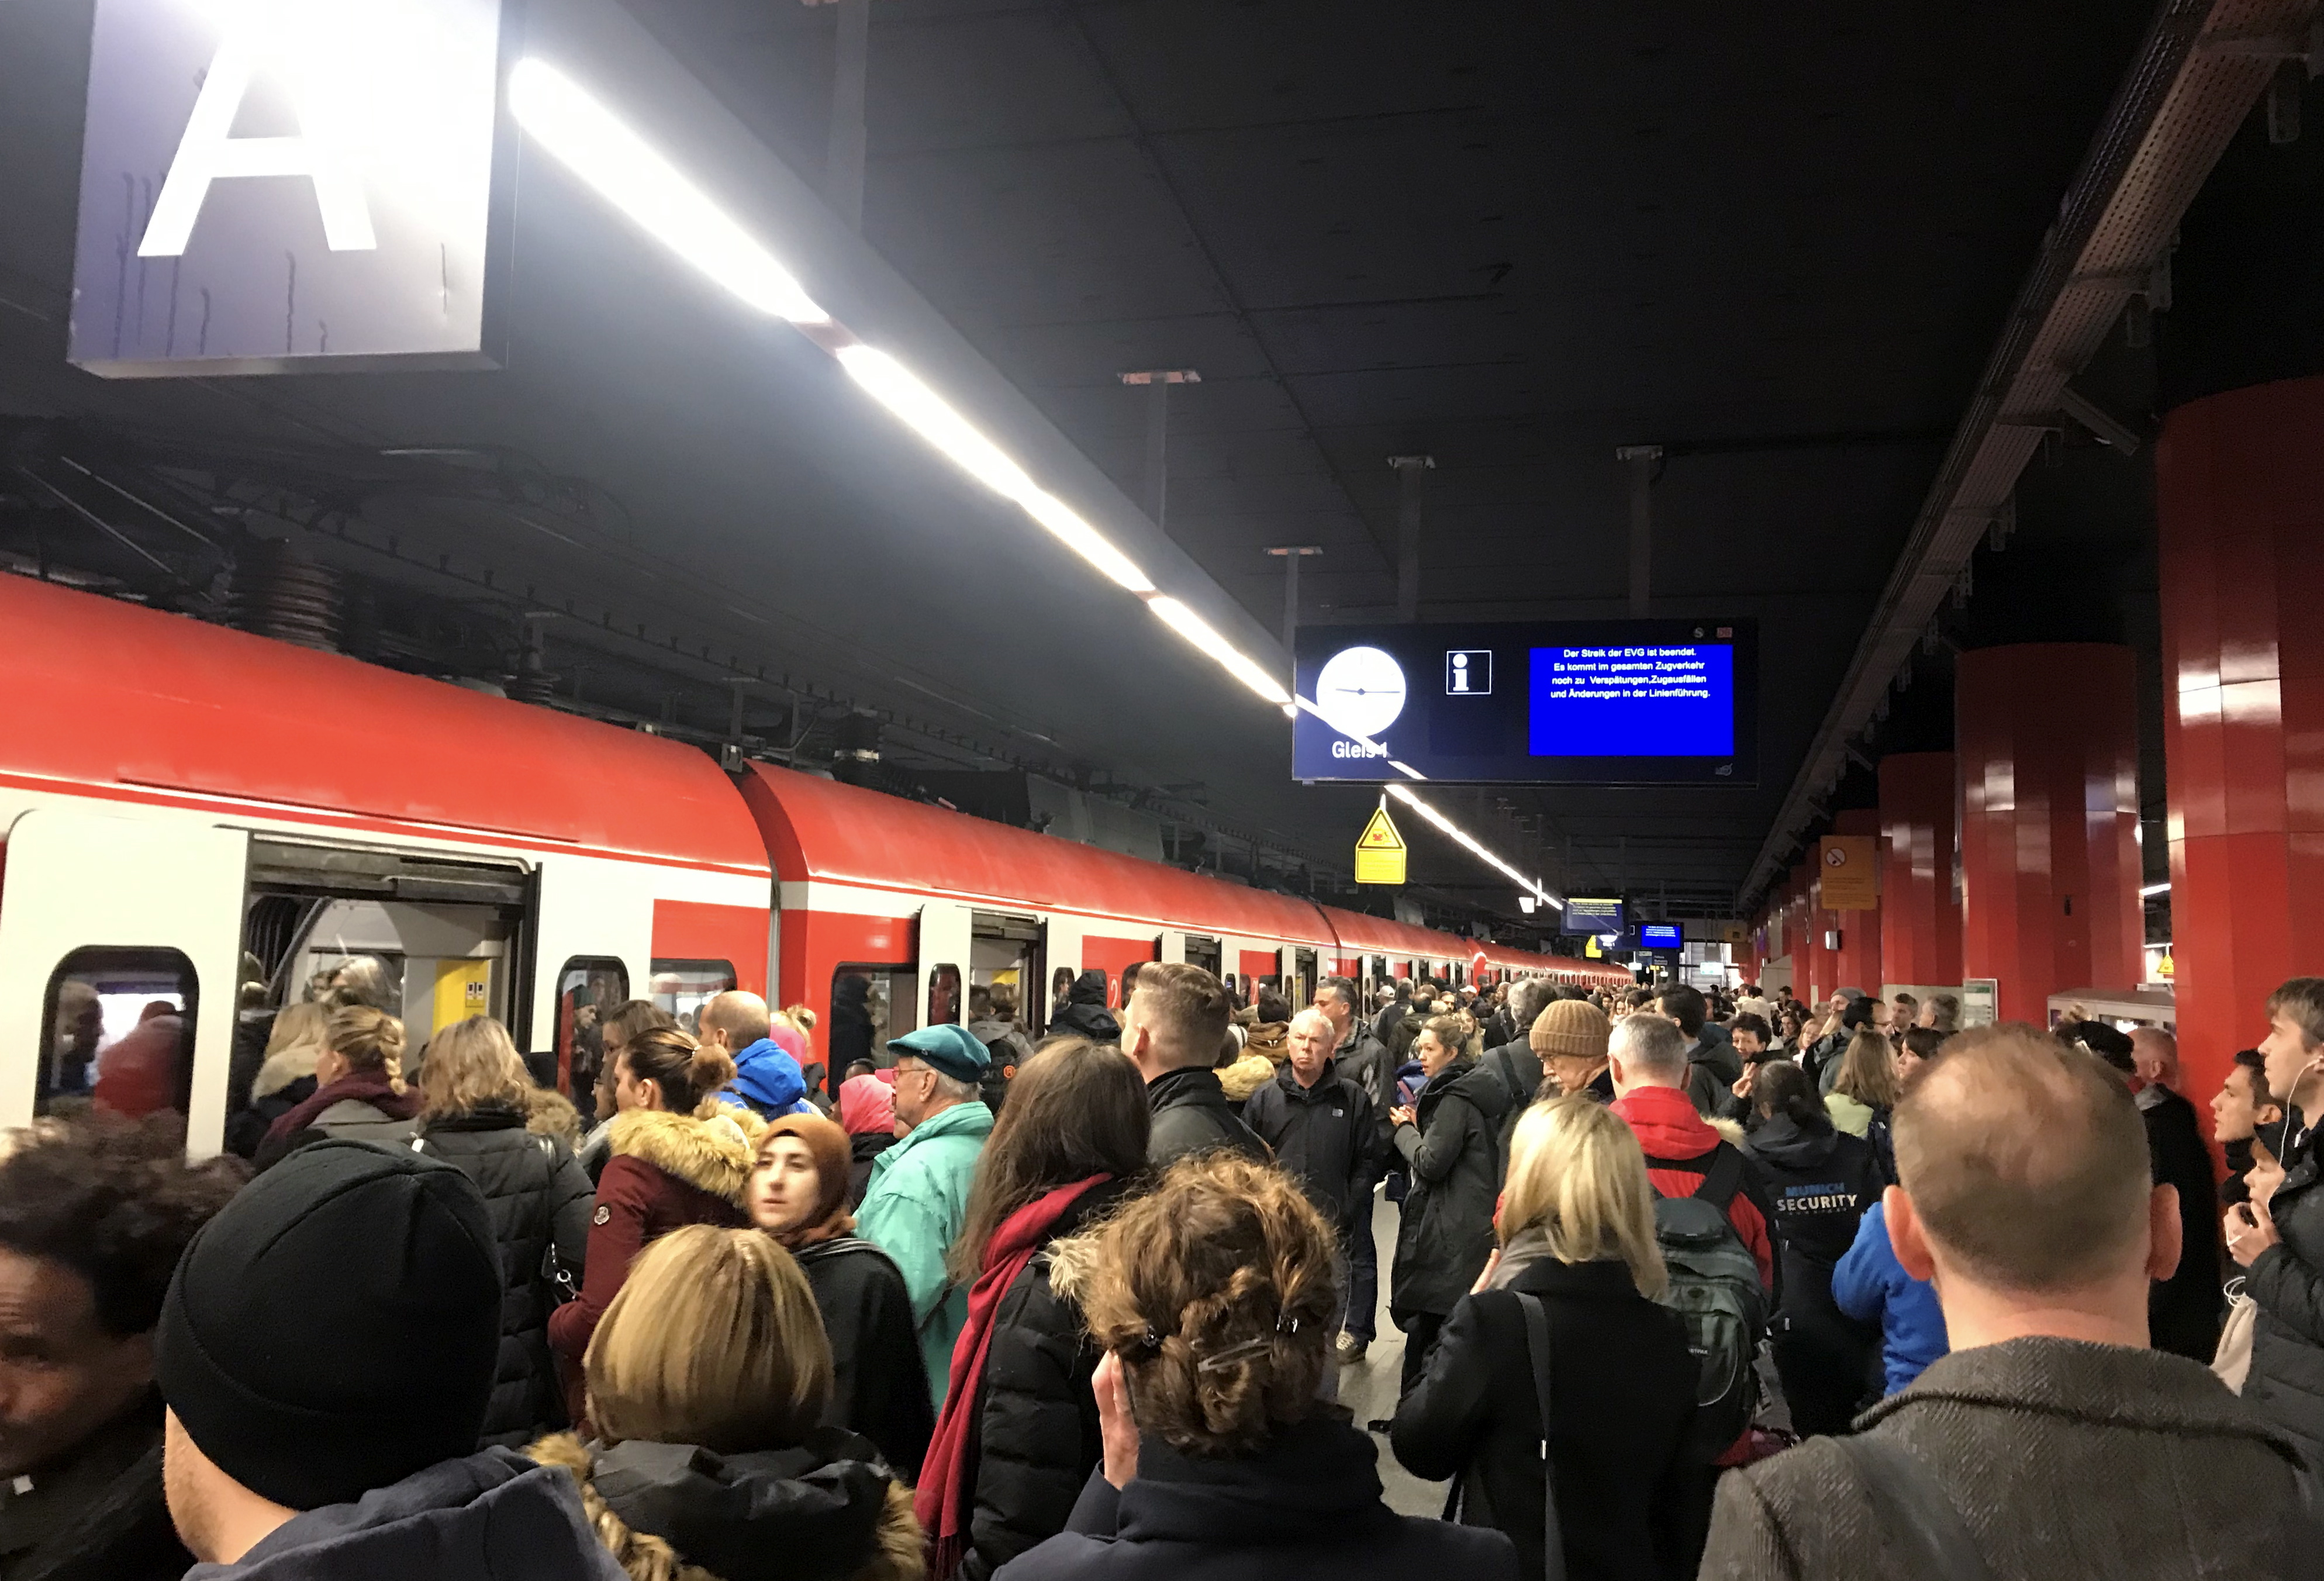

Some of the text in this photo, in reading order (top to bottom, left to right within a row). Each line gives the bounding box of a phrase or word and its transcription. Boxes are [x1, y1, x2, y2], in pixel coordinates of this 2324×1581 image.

[137, 0, 378, 257] A
[1563, 647, 1697, 658] Der Streik der EVG ist beendet.
[1553, 661, 1705, 672] Es kommt im gesamten Zugverkehr
[1552, 676, 1573, 685] noch
[1551, 688, 1711, 699] und Änderungen in der Linienführung.
[1785, 1182, 1845, 1197] MUNICH
[1777, 1194, 1857, 1212] SECURITY
